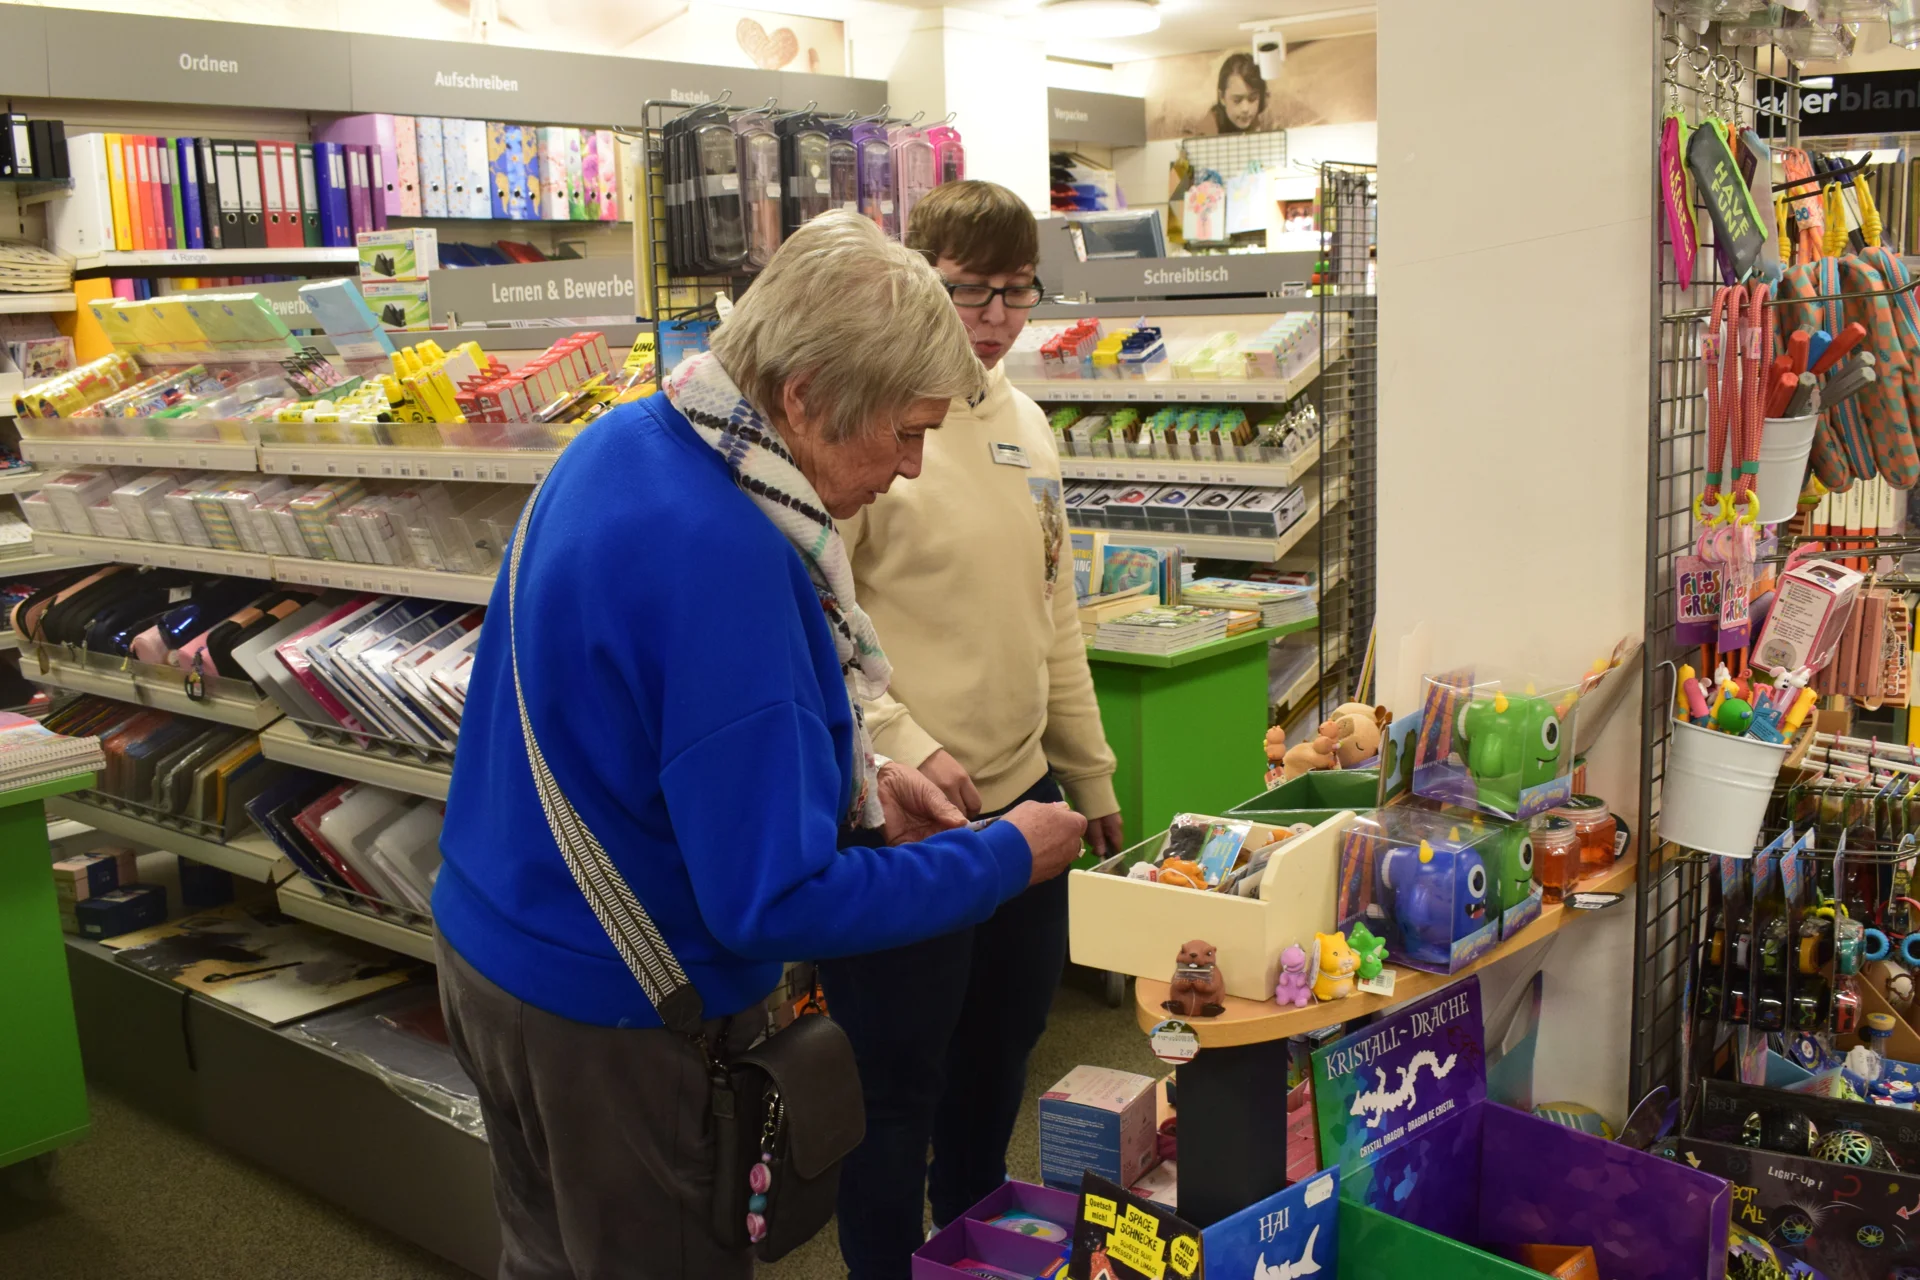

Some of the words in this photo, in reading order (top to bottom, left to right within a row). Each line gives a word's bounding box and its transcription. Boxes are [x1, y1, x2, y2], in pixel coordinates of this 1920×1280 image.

[180, 53, 238, 73] Ordnen
[435, 70, 518, 91] Aufschreiben
[1714, 160, 1750, 236] HAVE
[1711, 178, 1741, 242] FUN!
[1144, 266, 1229, 285] Schreibtisch
[492, 283, 542, 303] Lernen
[547, 280, 560, 300] &
[564, 274, 634, 299] Bewerbe
[1410, 992, 1469, 1037] DRACHE
[1360, 1138, 1383, 1158] CRYSTAL
[1383, 1126, 1404, 1145] DRAGON
[1407, 1113, 1428, 1132] DRAGON
[1428, 1110, 1435, 1121] DE
[1435, 1098, 1455, 1117] CRISTAL
[1089, 1198, 1112, 1211] Quetsch
[1741, 1203, 1767, 1224] ALL
[1092, 1211, 1108, 1221] mich!
[1128, 1211, 1154, 1232] SPACE-
[1258, 1206, 1290, 1243] HAI
[1120, 1223, 1158, 1251] SCHNECKE
[1179, 1239, 1194, 1258] WILD
[1174, 1253, 1189, 1272] COOL
